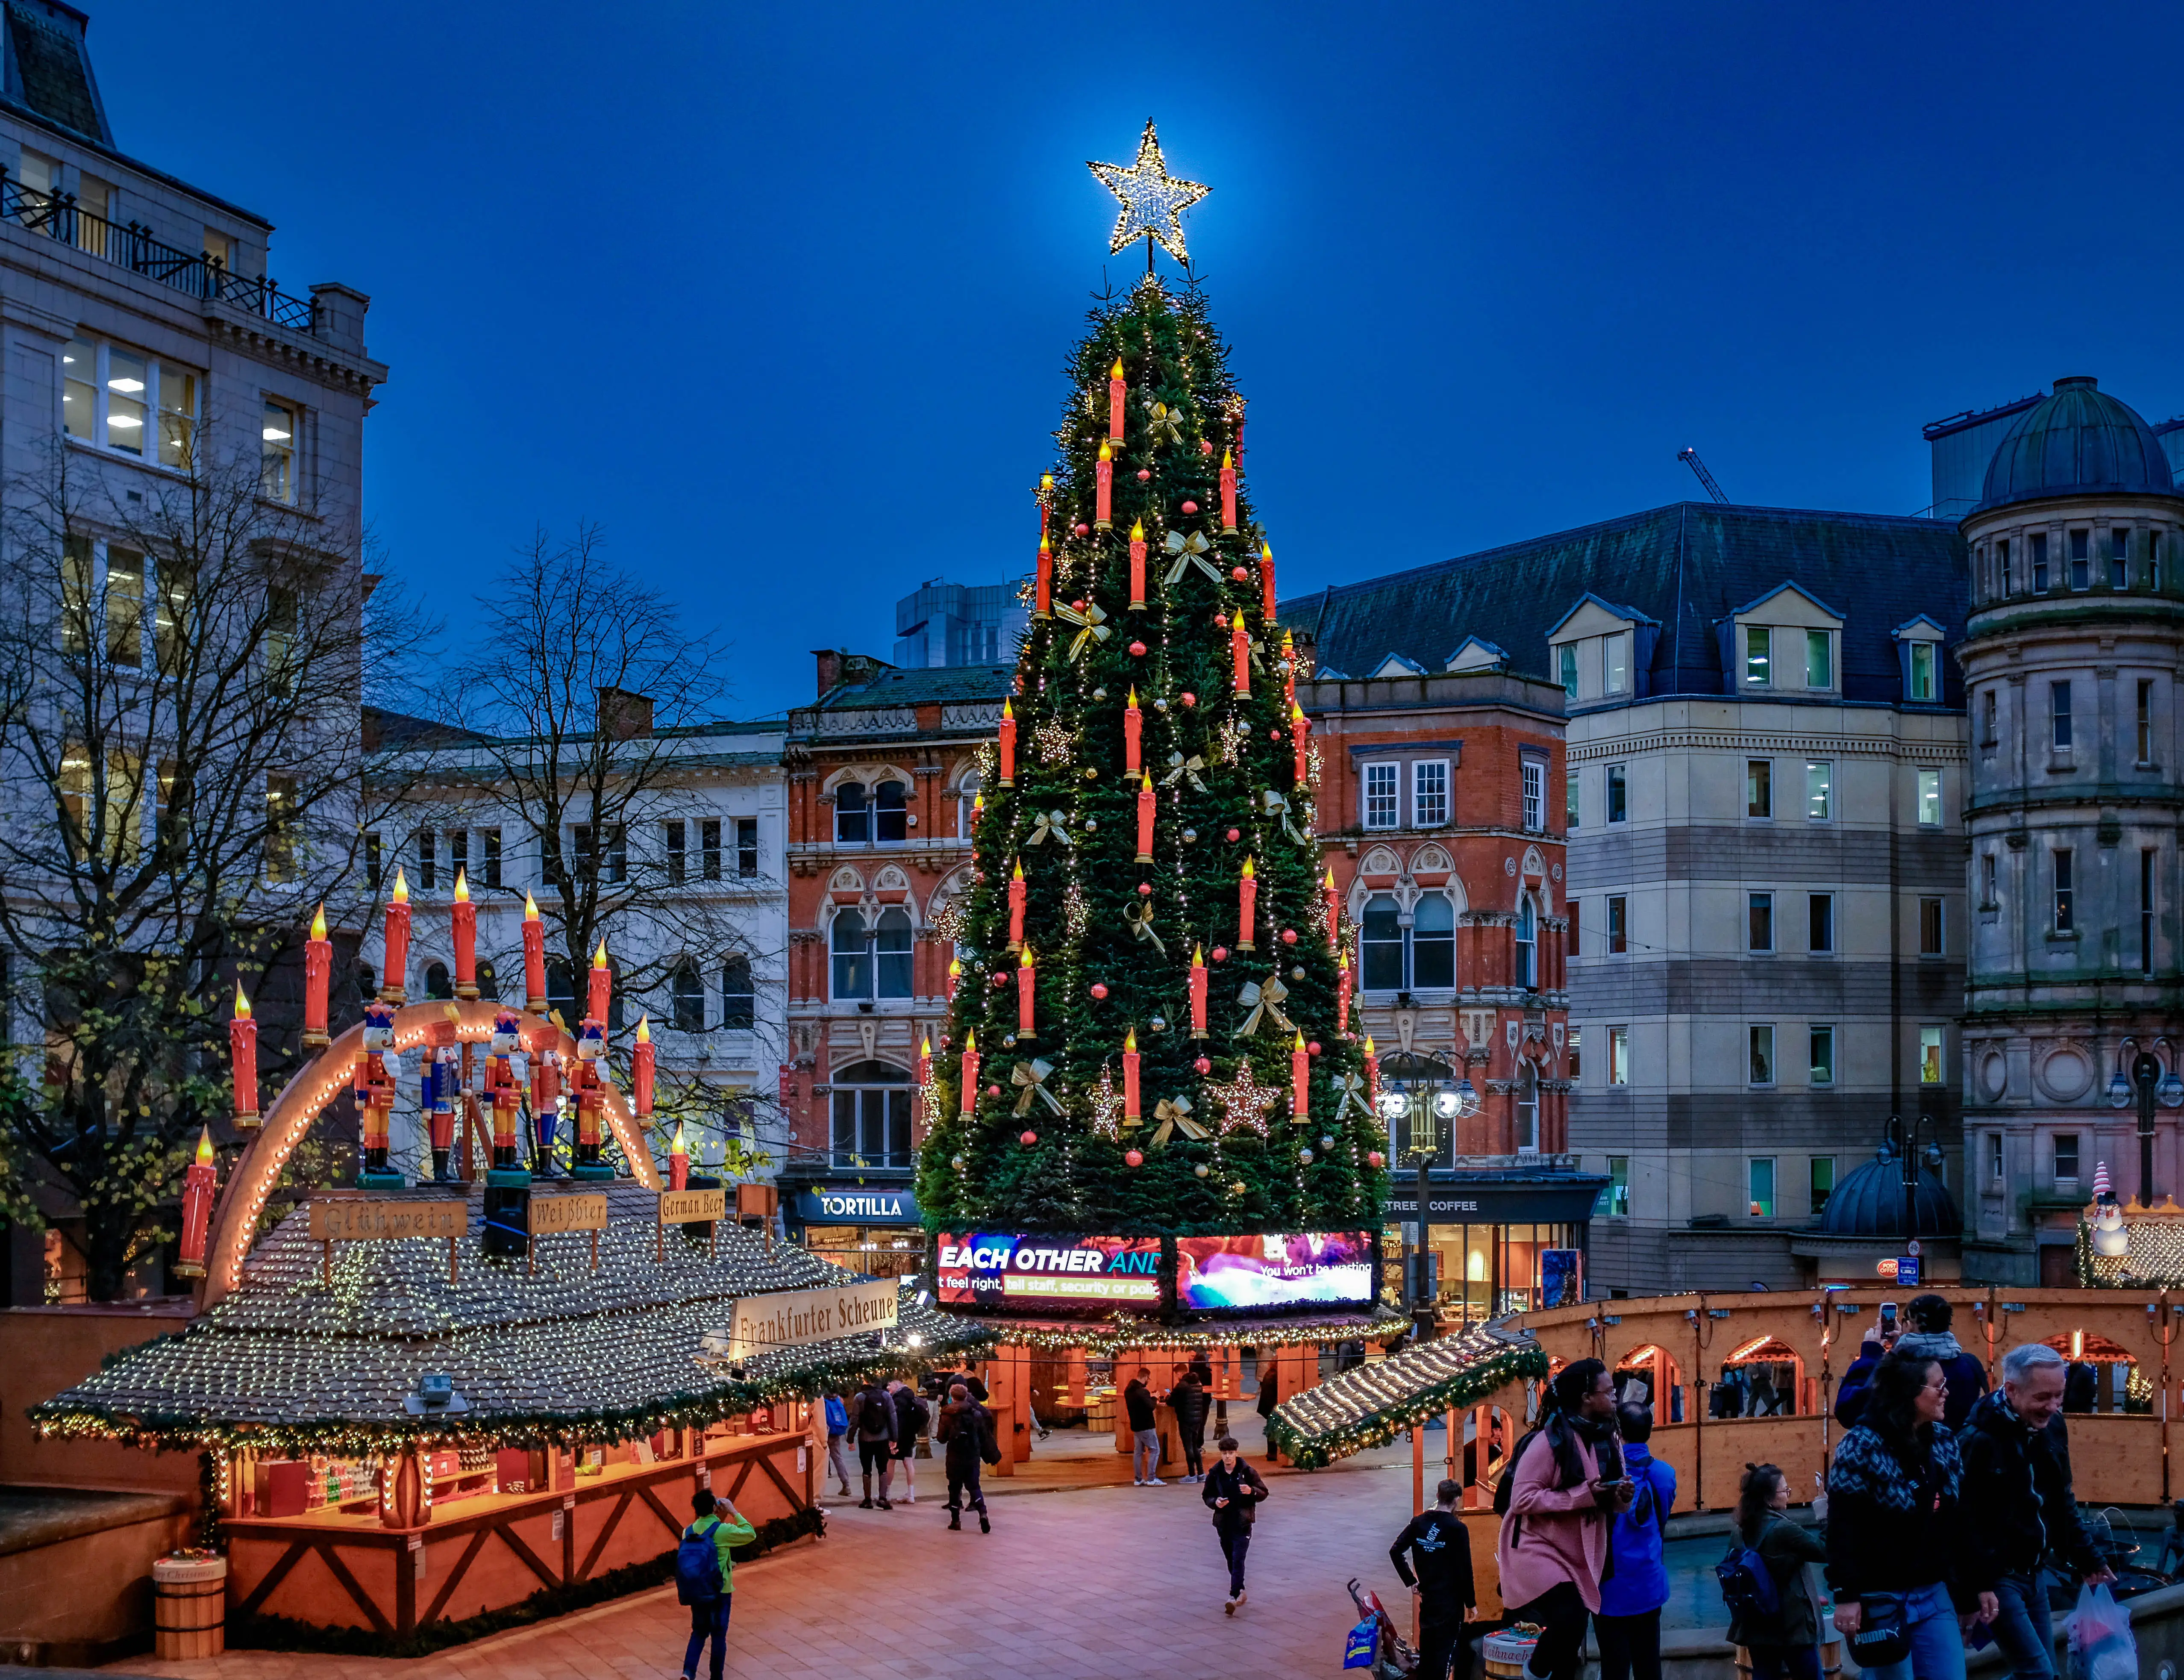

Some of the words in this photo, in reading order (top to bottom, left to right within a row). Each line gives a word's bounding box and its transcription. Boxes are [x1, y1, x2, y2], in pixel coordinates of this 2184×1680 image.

[535, 1198, 603, 1230] Weißbier
[663, 1196, 700, 1218] German
[704, 1194, 723, 1214] Beer
[821, 1197, 902, 1215] TORTILLA
[1384, 1201, 1419, 1211] TREE
[1429, 1201, 1477, 1211] COFFEE
[324, 1205, 454, 1236] Glühwein
[939, 1246, 1011, 1269] EACH
[1015, 1248, 1103, 1272] OTHER
[1261, 1265, 1281, 1277] You
[1283, 1264, 1314, 1276] won't
[1316, 1263, 1330, 1274] be
[1331, 1262, 1372, 1273] wasting
[946, 1276, 968, 1289] feel
[972, 1277, 1003, 1291] right,
[1006, 1279, 1025, 1290] tell
[1028, 1279, 1058, 1293] staff,
[1060, 1281, 1109, 1295] security
[1112, 1285, 1127, 1294] or
[741, 1304, 831, 1348] Frankfurter
[839, 1296, 893, 1328] Scheune
[1855, 1629, 1887, 1645] PUMA
